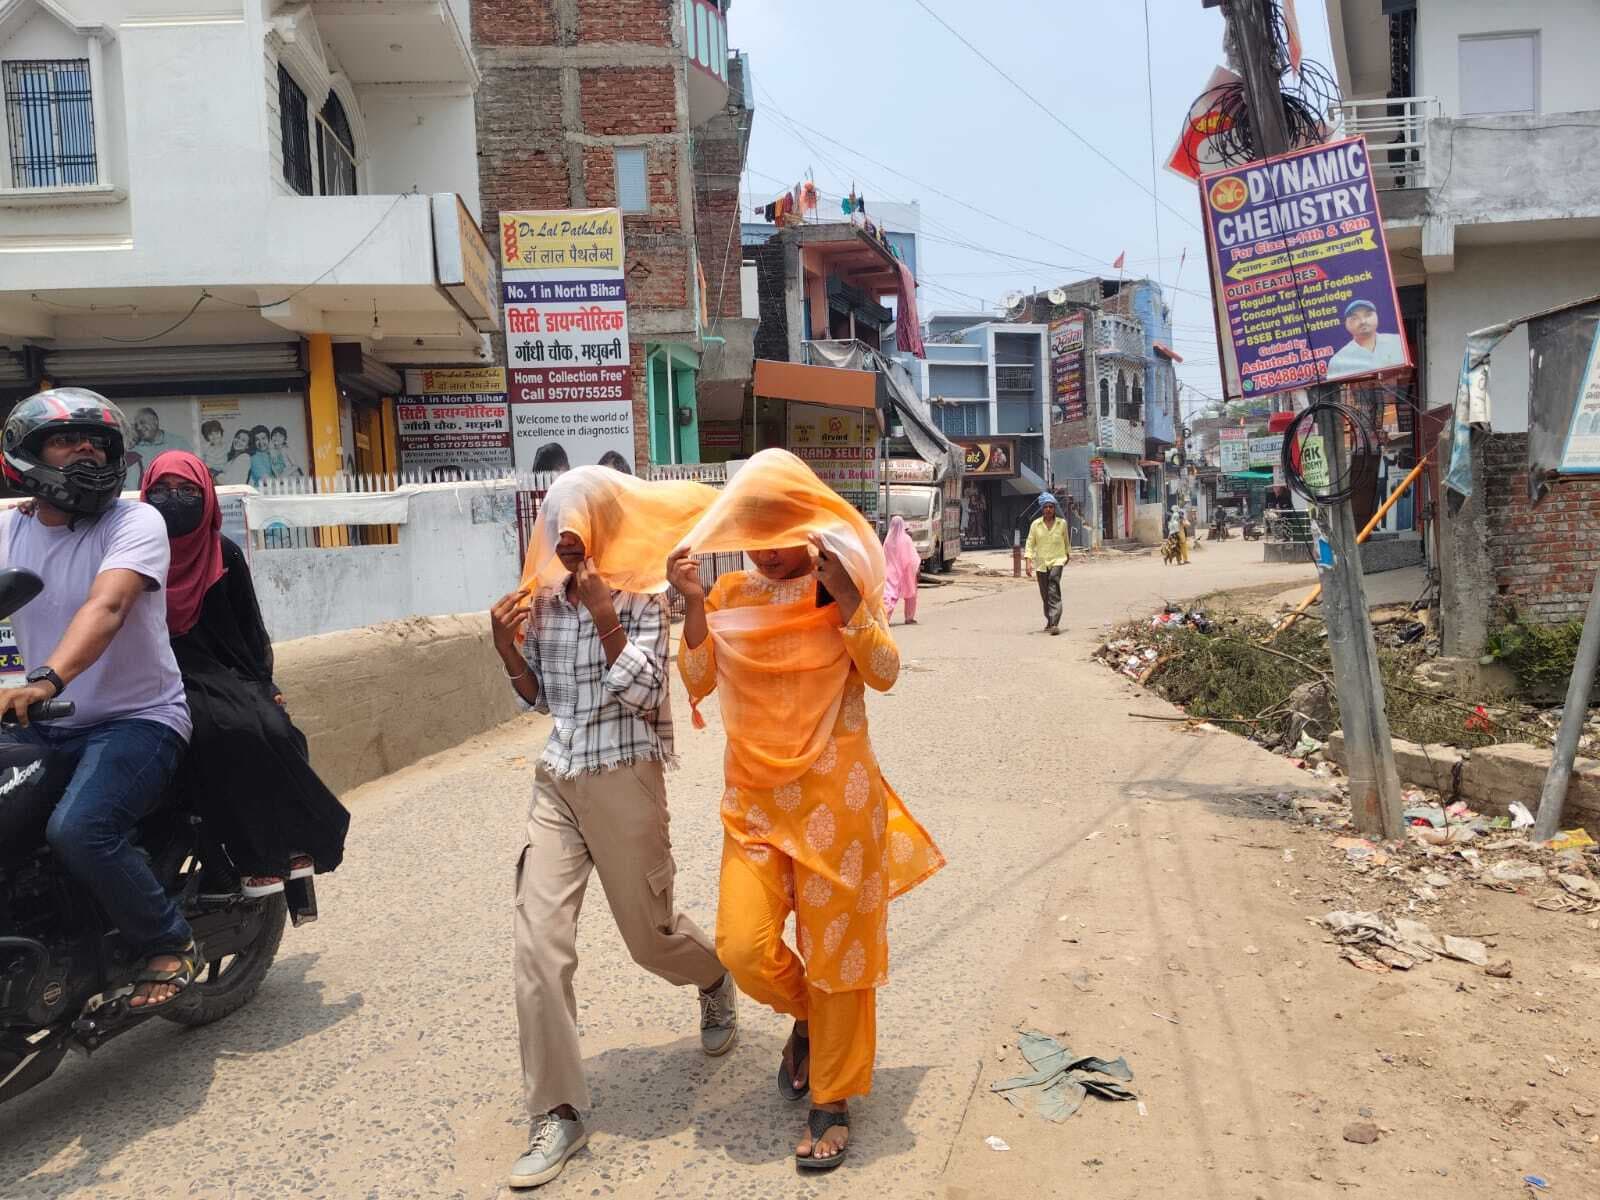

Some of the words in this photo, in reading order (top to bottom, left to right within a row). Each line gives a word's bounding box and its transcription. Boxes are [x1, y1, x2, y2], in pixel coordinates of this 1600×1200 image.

[1247, 144, 1366, 203] DYNAMIC
[1218, 183, 1368, 246] CHEMISTRY
[519, 222, 534, 237] Dr
[537, 222, 558, 237] Lal
[561, 220, 612, 236] PathLabs
[1231, 247, 1253, 261] For
[1326, 224, 1338, 237] &
[1340, 217, 1370, 233] 12th
[522, 245, 537, 263] डॉ
[540, 249, 565, 263] लाल
[508, 286, 527, 299] No.
[531, 286, 537, 298] 1
[541, 285, 551, 298] in
[554, 285, 587, 298] North
[591, 284, 620, 297] Bihar
[1227, 285, 1251, 297] OUR
[1256, 269, 1317, 290] FEATURES
[1240, 295, 1277, 309] Regular
[1280, 290, 1298, 299] Tes
[1303, 282, 1321, 294] And
[1324, 270, 1373, 289] Feedback
[1242, 301, 1296, 321] Conceptual
[1299, 290, 1352, 308] Knowledge
[507, 308, 540, 333] सिटी
[544, 306, 624, 332] डायग्नोस्टिक
[1244, 319, 1281, 334] Lecture
[1308, 306, 1337, 319] Notes
[1246, 332, 1272, 346] BSEB
[1275, 327, 1302, 339] Exam
[1304, 318, 1340, 332] Pattern
[514, 340, 545, 361] गाँधी
[581, 338, 621, 365] मधुबनी
[1241, 352, 1299, 375] Ashutosh
[514, 372, 543, 384] Home
[548, 370, 598, 383] Collection
[442, 395, 473, 403] North
[475, 394, 503, 402] Bihar
[521, 388, 545, 400] Call
[548, 386, 622, 399] 9570755255
[516, 415, 559, 425] Welcome
[561, 415, 571, 423] to
[573, 413, 588, 423] the
[591, 413, 617, 422] world
[620, 412, 629, 421] of
[517, 428, 565, 437] excellence
[567, 427, 575, 435] in
[578, 426, 629, 438] diagnostics
[822, 433, 848, 441] Arvind
[835, 448, 873, 459] SELLR
[1302, 447, 1321, 462] AK
